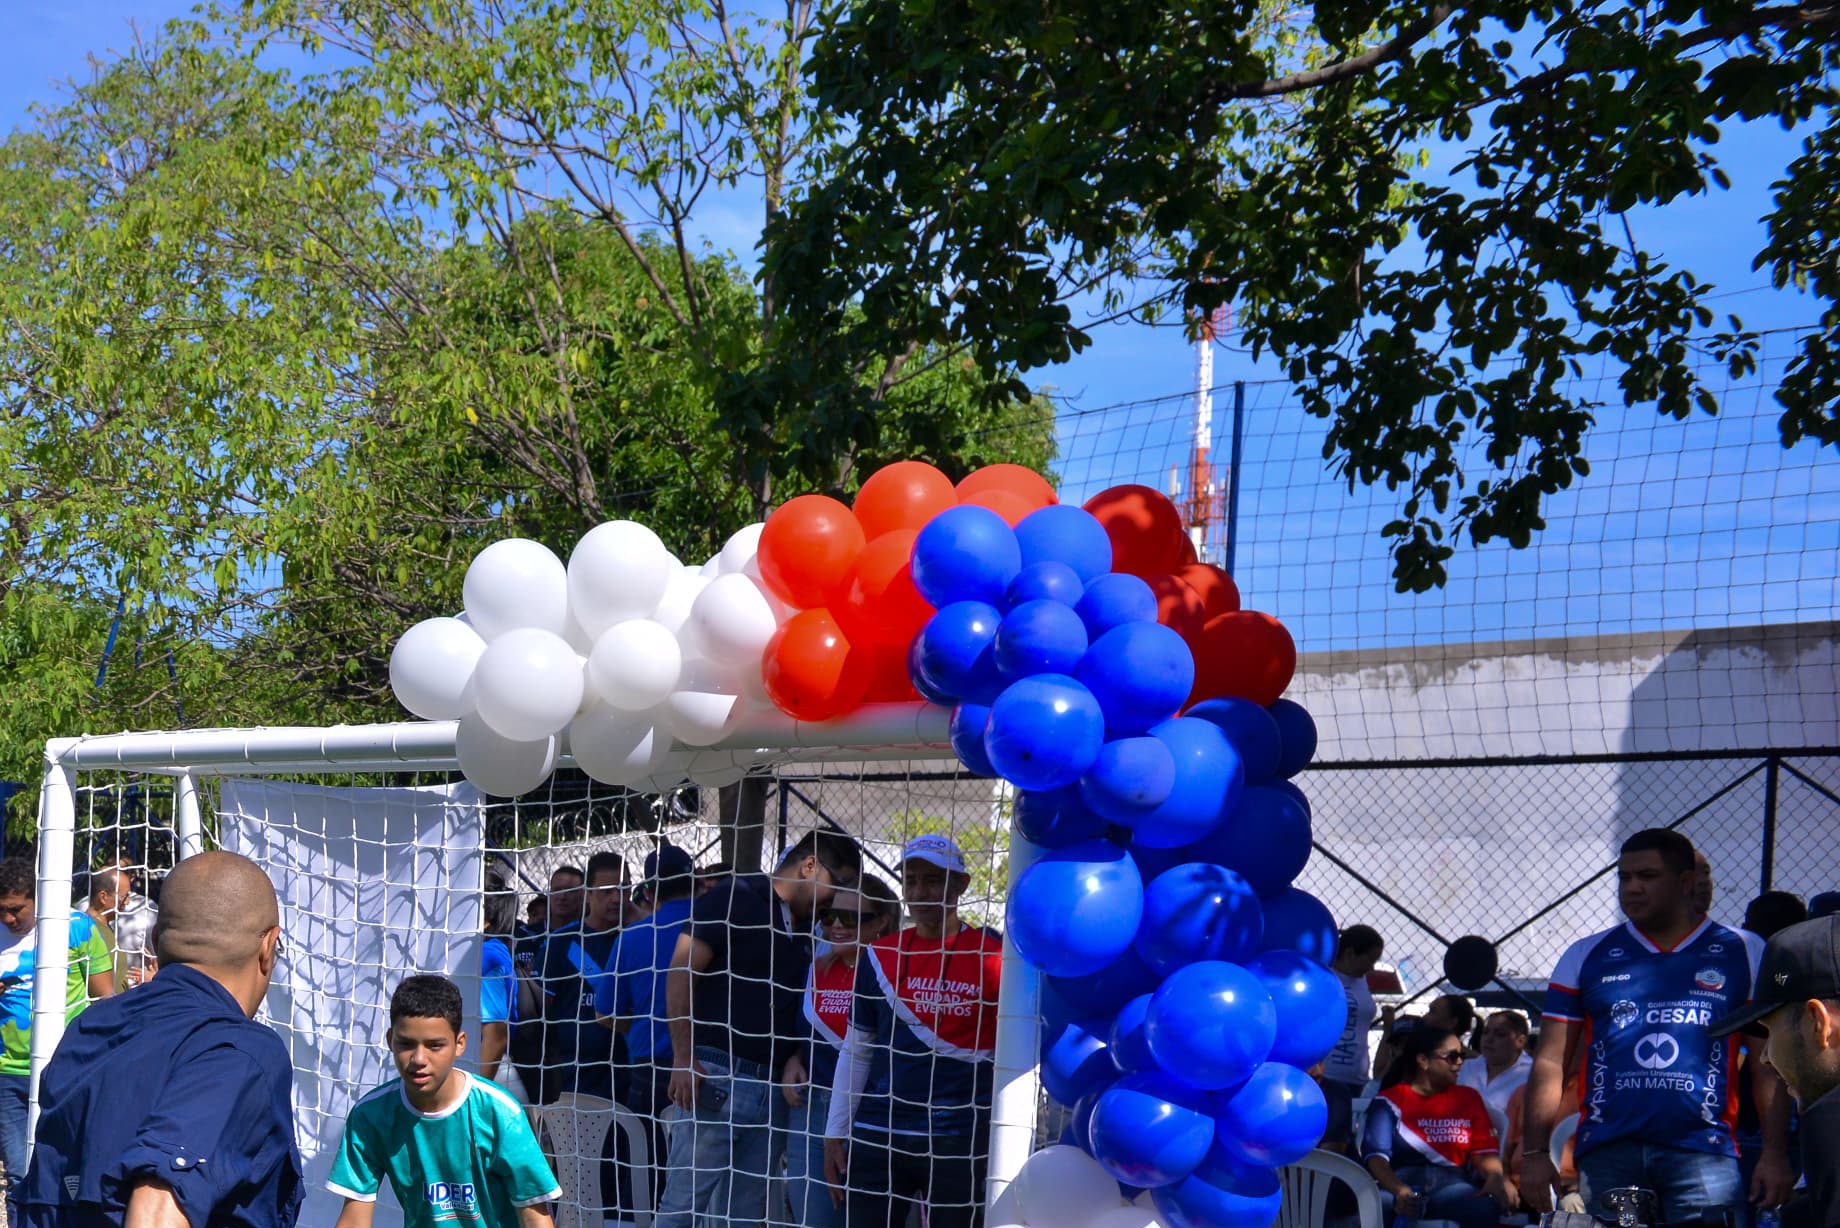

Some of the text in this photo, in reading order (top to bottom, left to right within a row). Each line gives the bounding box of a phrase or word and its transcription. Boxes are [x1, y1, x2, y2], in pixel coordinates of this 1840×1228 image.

[912, 991, 960, 1002] CIUDAD
[819, 1005, 849, 1015] EVENT
[915, 1004, 972, 1017] EVENTOS
[1646, 1008, 1712, 1026] CESAR
[1615, 1077, 1695, 1092] SAN MATEO
[1423, 1127, 1461, 1135] CIUDAD
[1426, 1134, 1469, 1144] EVENTOS
